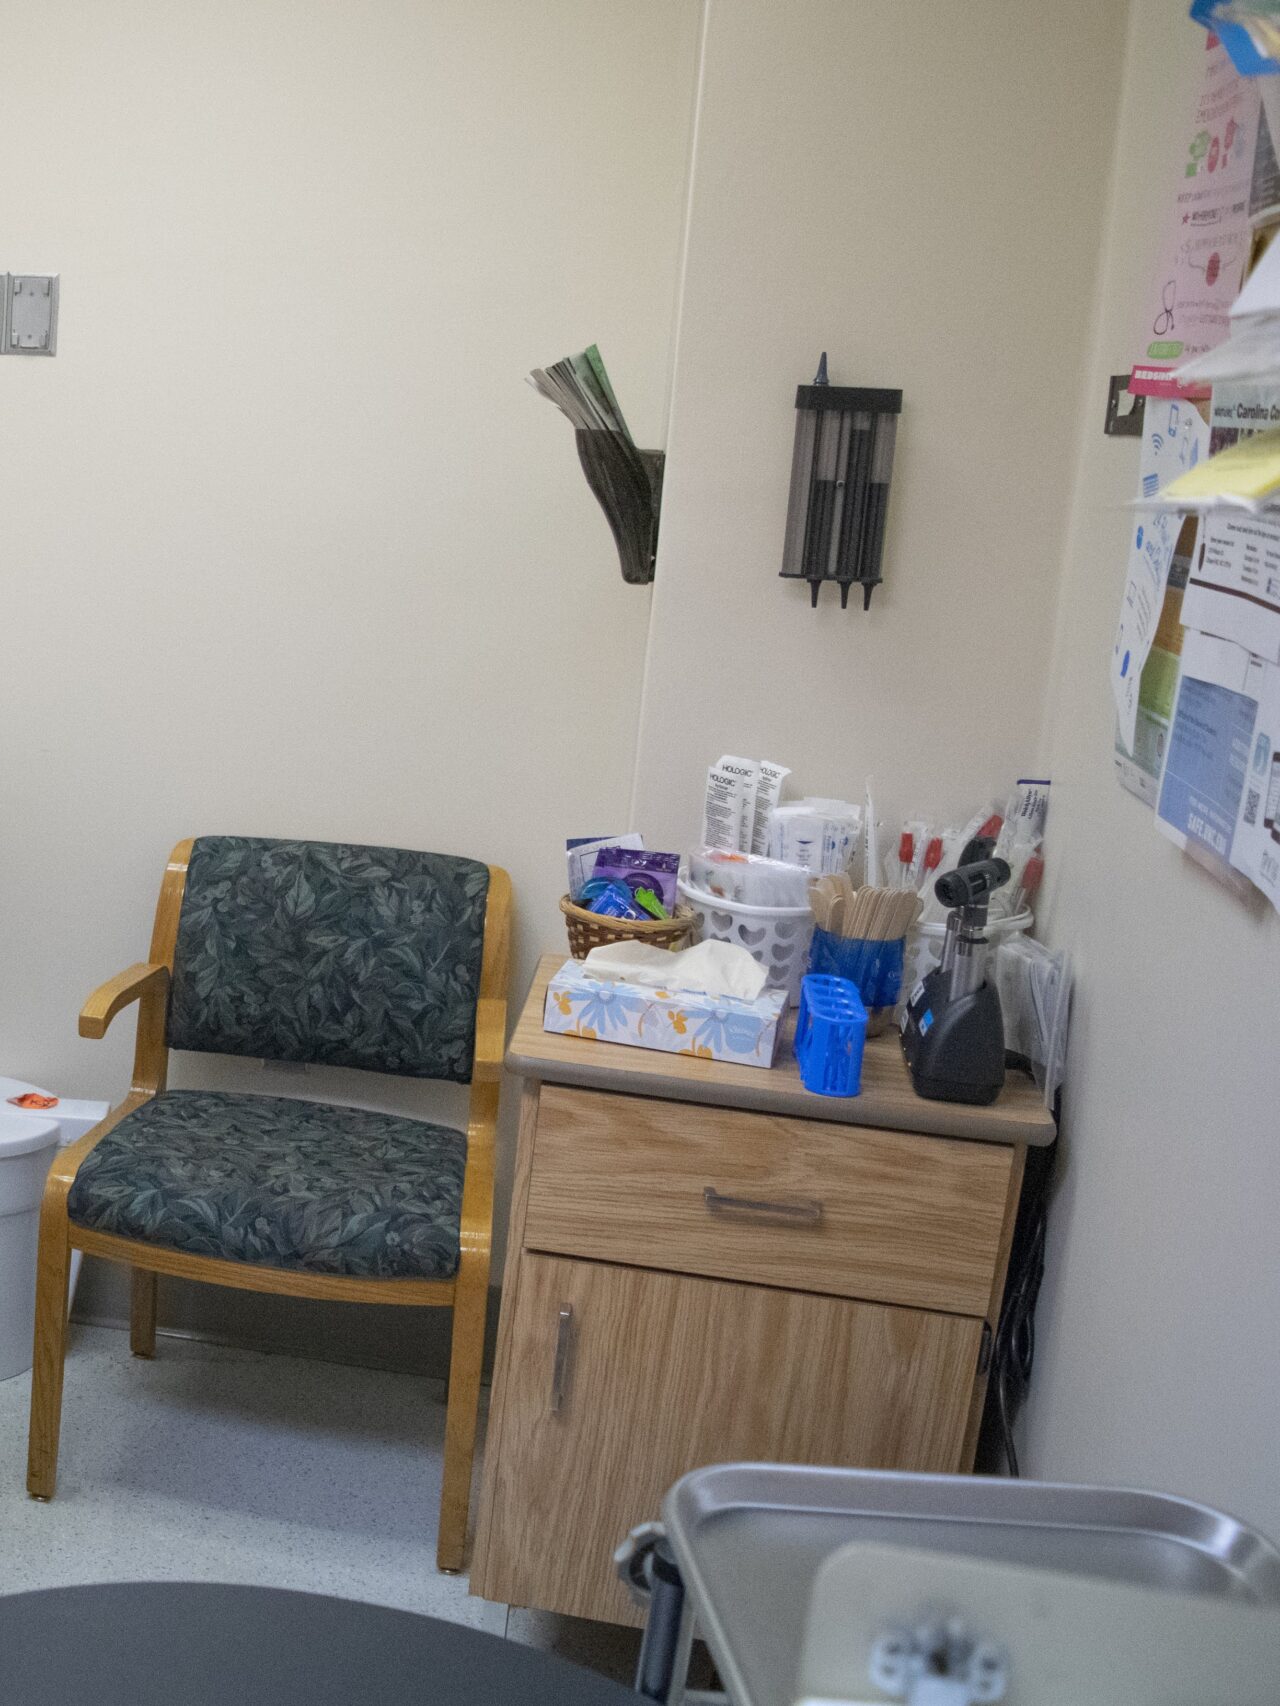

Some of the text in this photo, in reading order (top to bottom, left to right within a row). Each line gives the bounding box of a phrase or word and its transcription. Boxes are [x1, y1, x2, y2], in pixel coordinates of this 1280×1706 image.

[1236, 403, 1269, 420] Carolina
[722, 764, 753, 778] HOLOGIC
[710, 773, 736, 787] HOLOGIC
